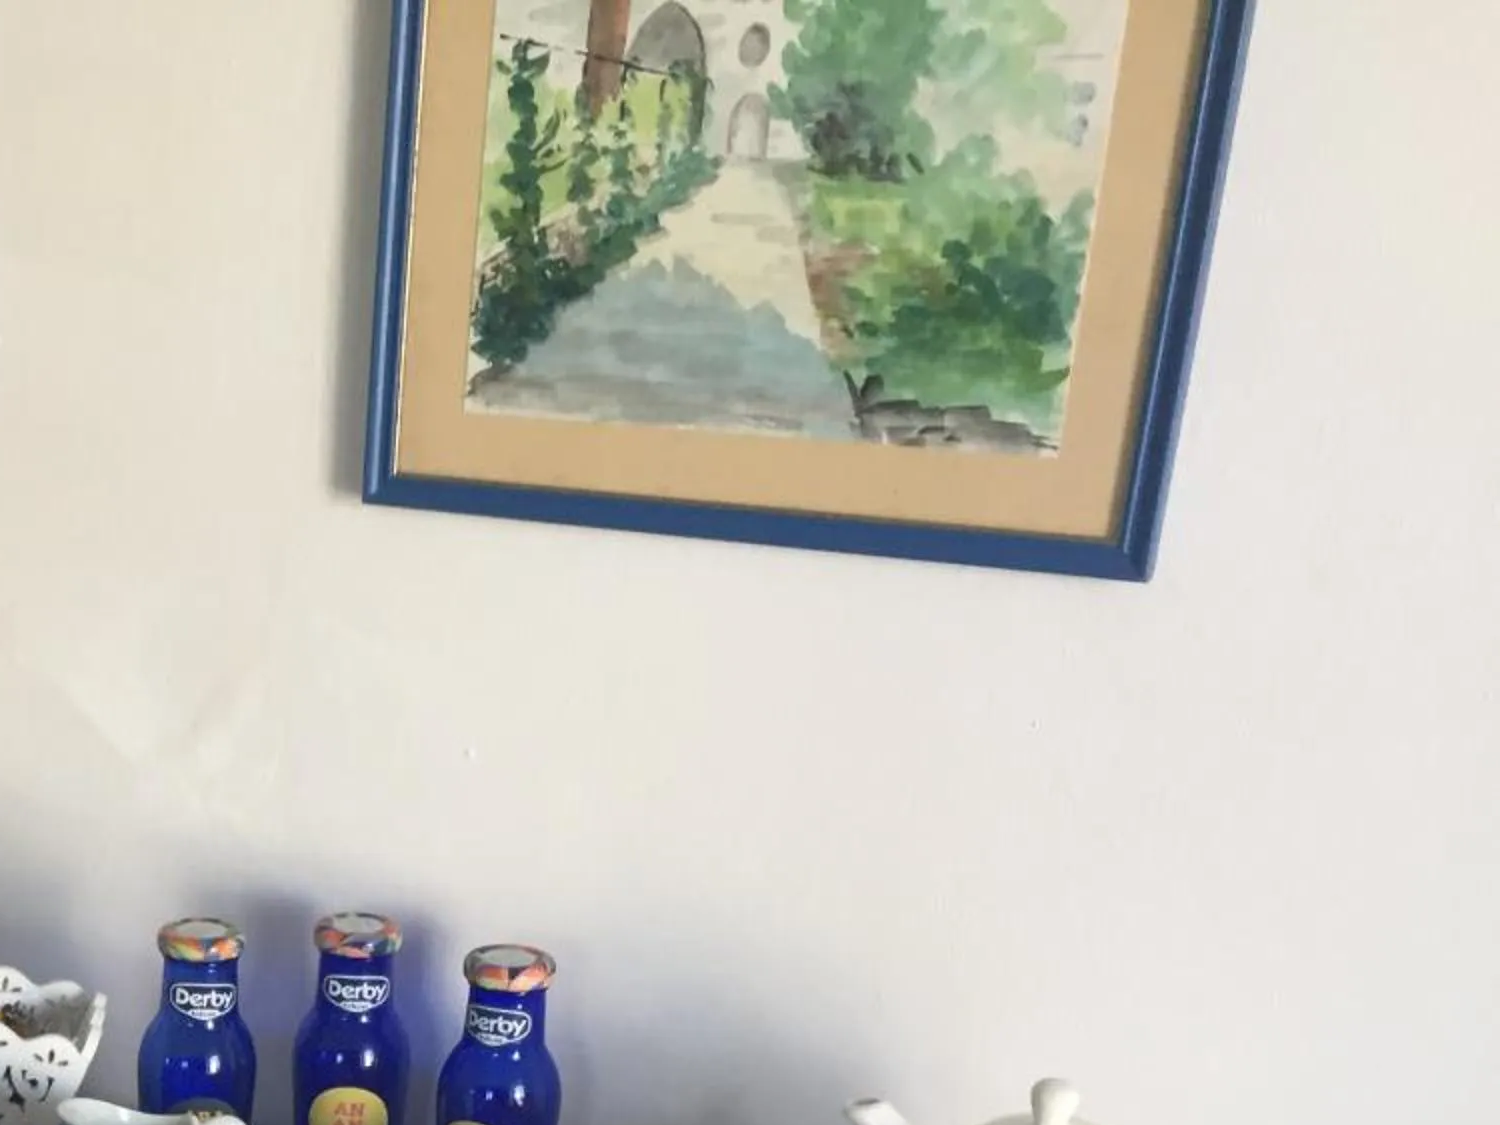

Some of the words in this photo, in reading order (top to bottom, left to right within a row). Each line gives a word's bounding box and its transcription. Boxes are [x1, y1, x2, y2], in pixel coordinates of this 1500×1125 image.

[174, 987, 233, 1009] Derby
[328, 979, 387, 1001] Derby
[468, 1009, 527, 1037] Derby
[333, 1102, 365, 1117] AN
